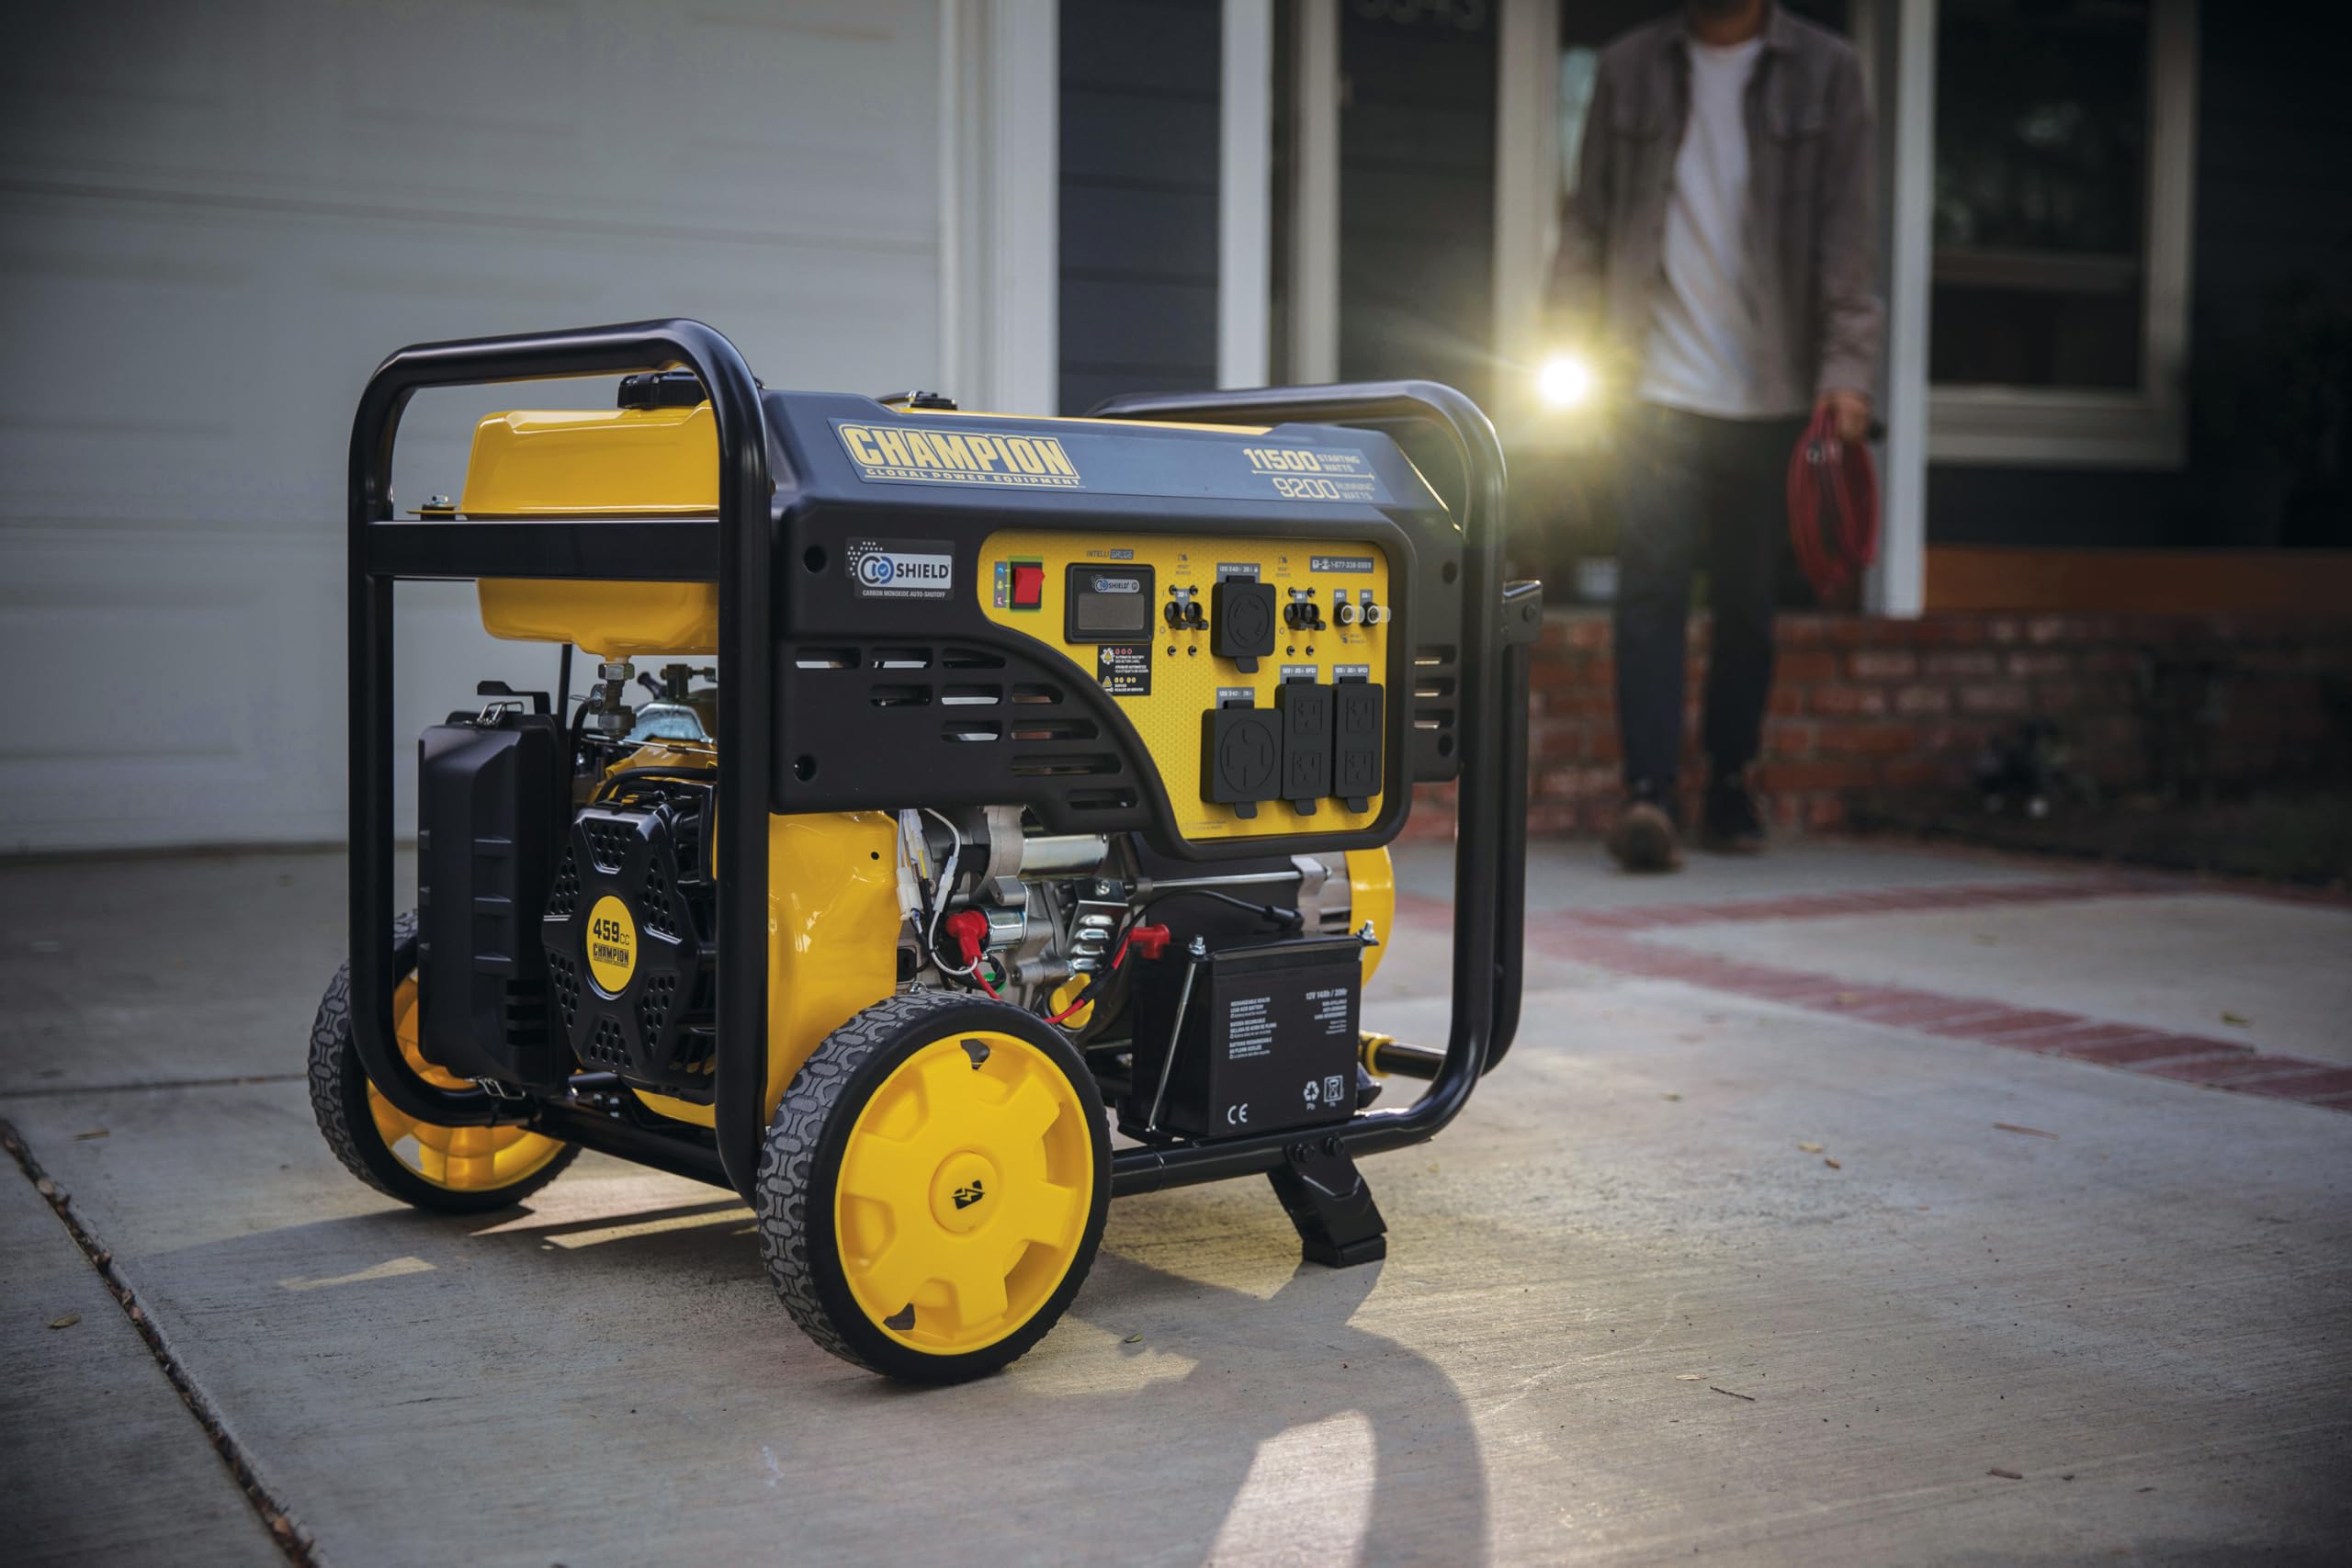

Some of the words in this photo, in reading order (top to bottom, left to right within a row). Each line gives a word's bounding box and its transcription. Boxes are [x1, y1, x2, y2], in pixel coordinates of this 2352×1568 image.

[840, 425, 1078, 478] CHAMPION
[1243, 448, 1321, 471] 11500
[865, 468, 927, 479] GLOBAL
[932, 471, 987, 481] POWER
[993, 475, 1080, 486] EQUIPMENT
[1272, 478, 1340, 499] 9200
[896, 563, 948, 579] SHIELD
[593, 942, 629, 964] CHAMPION
[1227, 1103, 1249, 1125] CE
